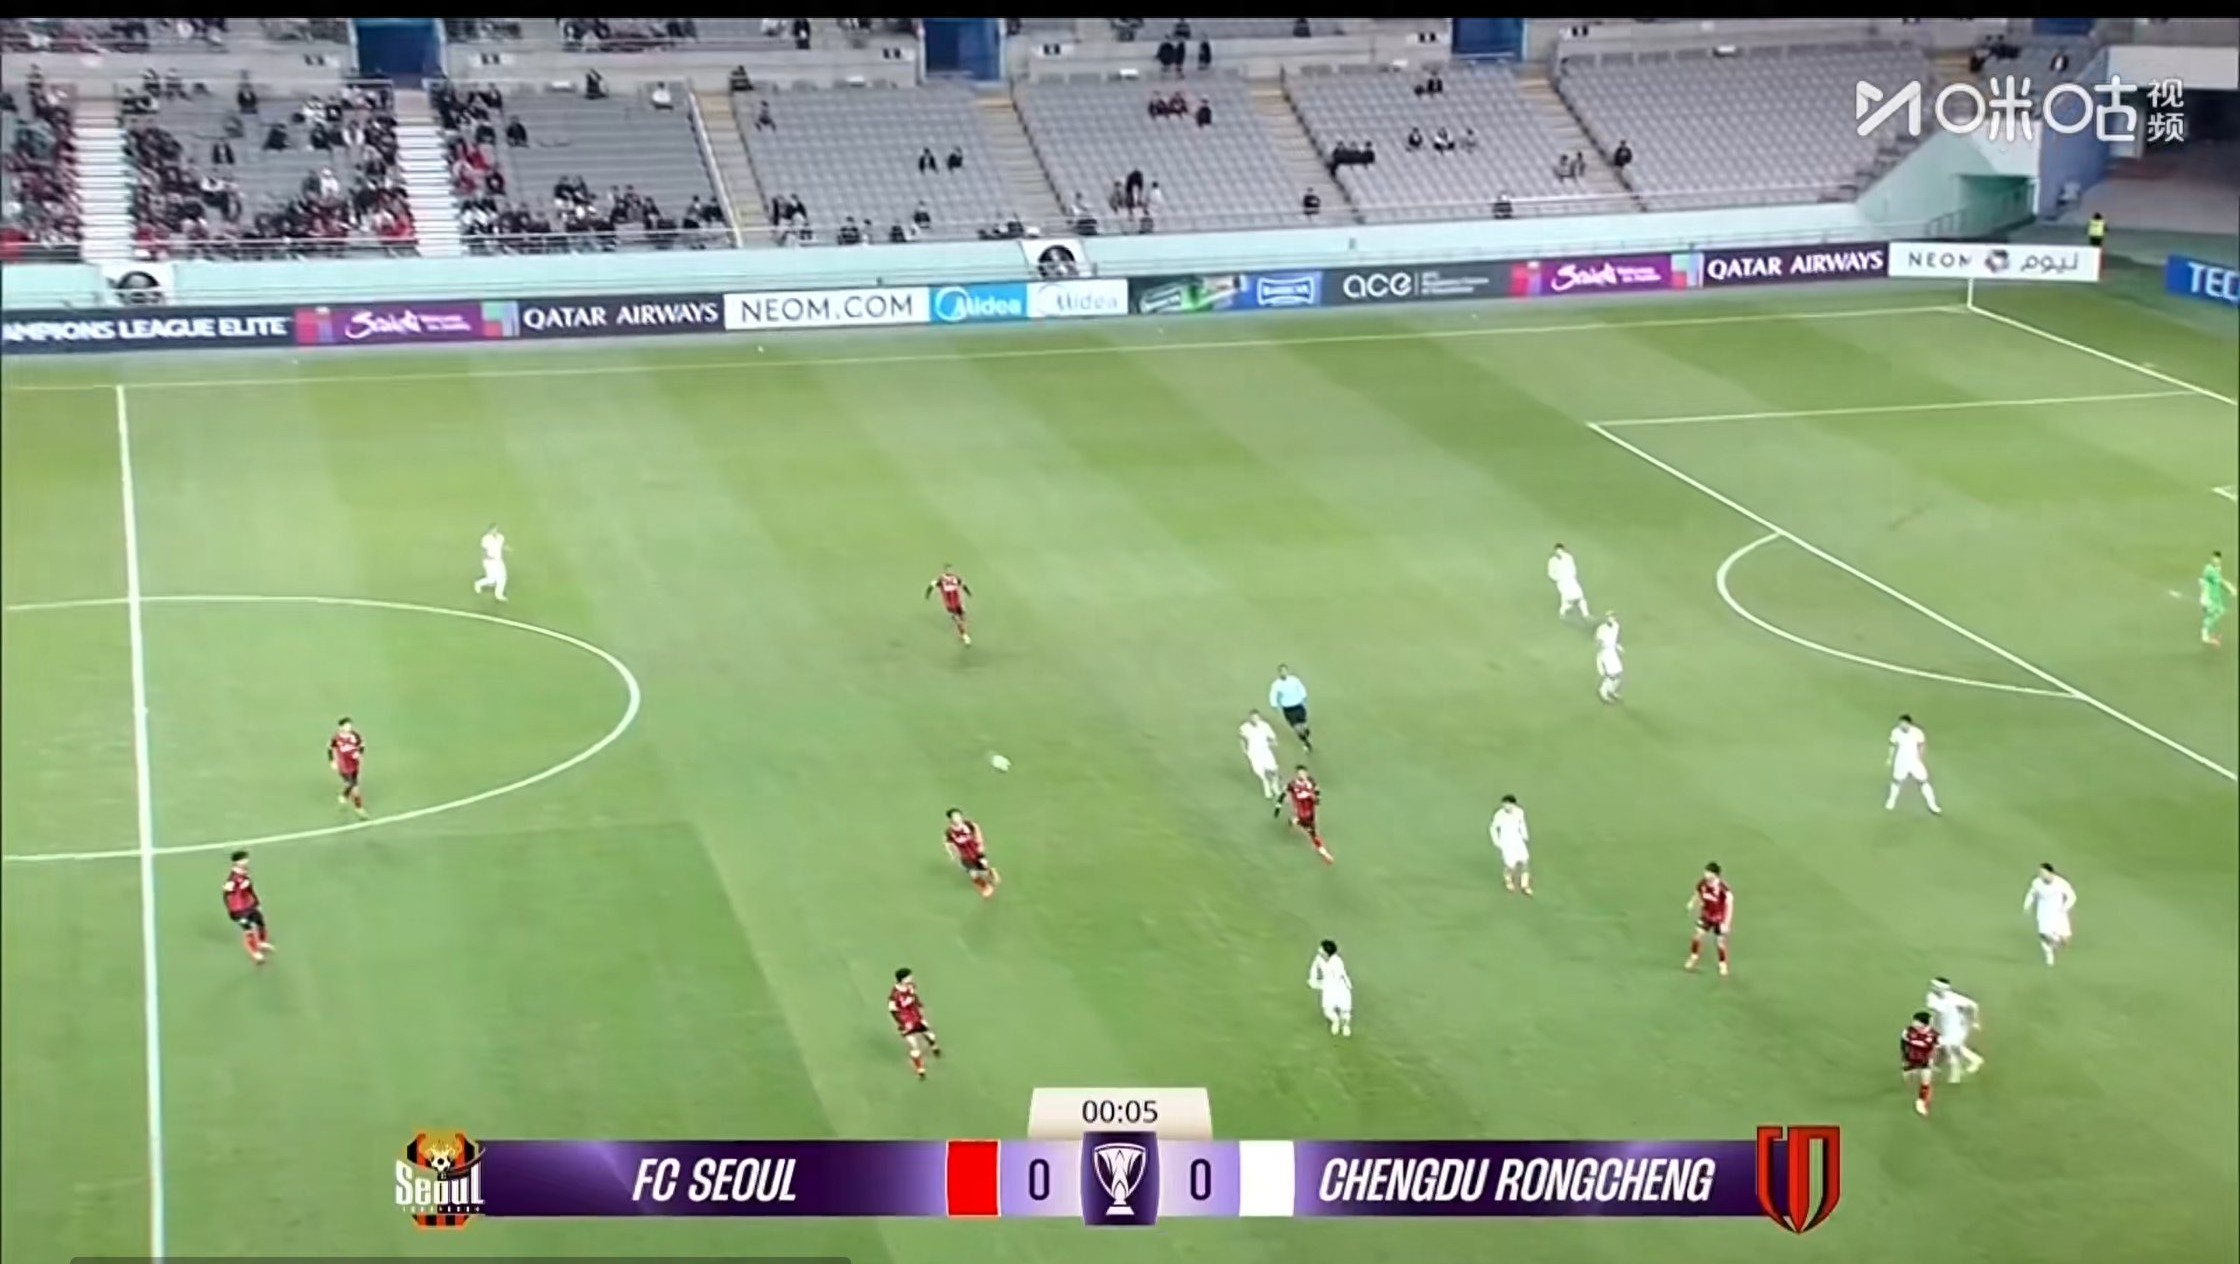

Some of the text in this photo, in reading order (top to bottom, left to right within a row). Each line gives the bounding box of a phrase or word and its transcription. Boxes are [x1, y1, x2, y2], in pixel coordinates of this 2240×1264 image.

[1707, 251, 1883, 280] QATAR AIRWAYS
[1343, 271, 1412, 298] ace
[523, 302, 719, 330] QATAR AIRWAYS
[741, 294, 912, 322] NEOM.COM
[118, 317, 216, 339] LEAGUE
[218, 316, 288, 336] ELITE
